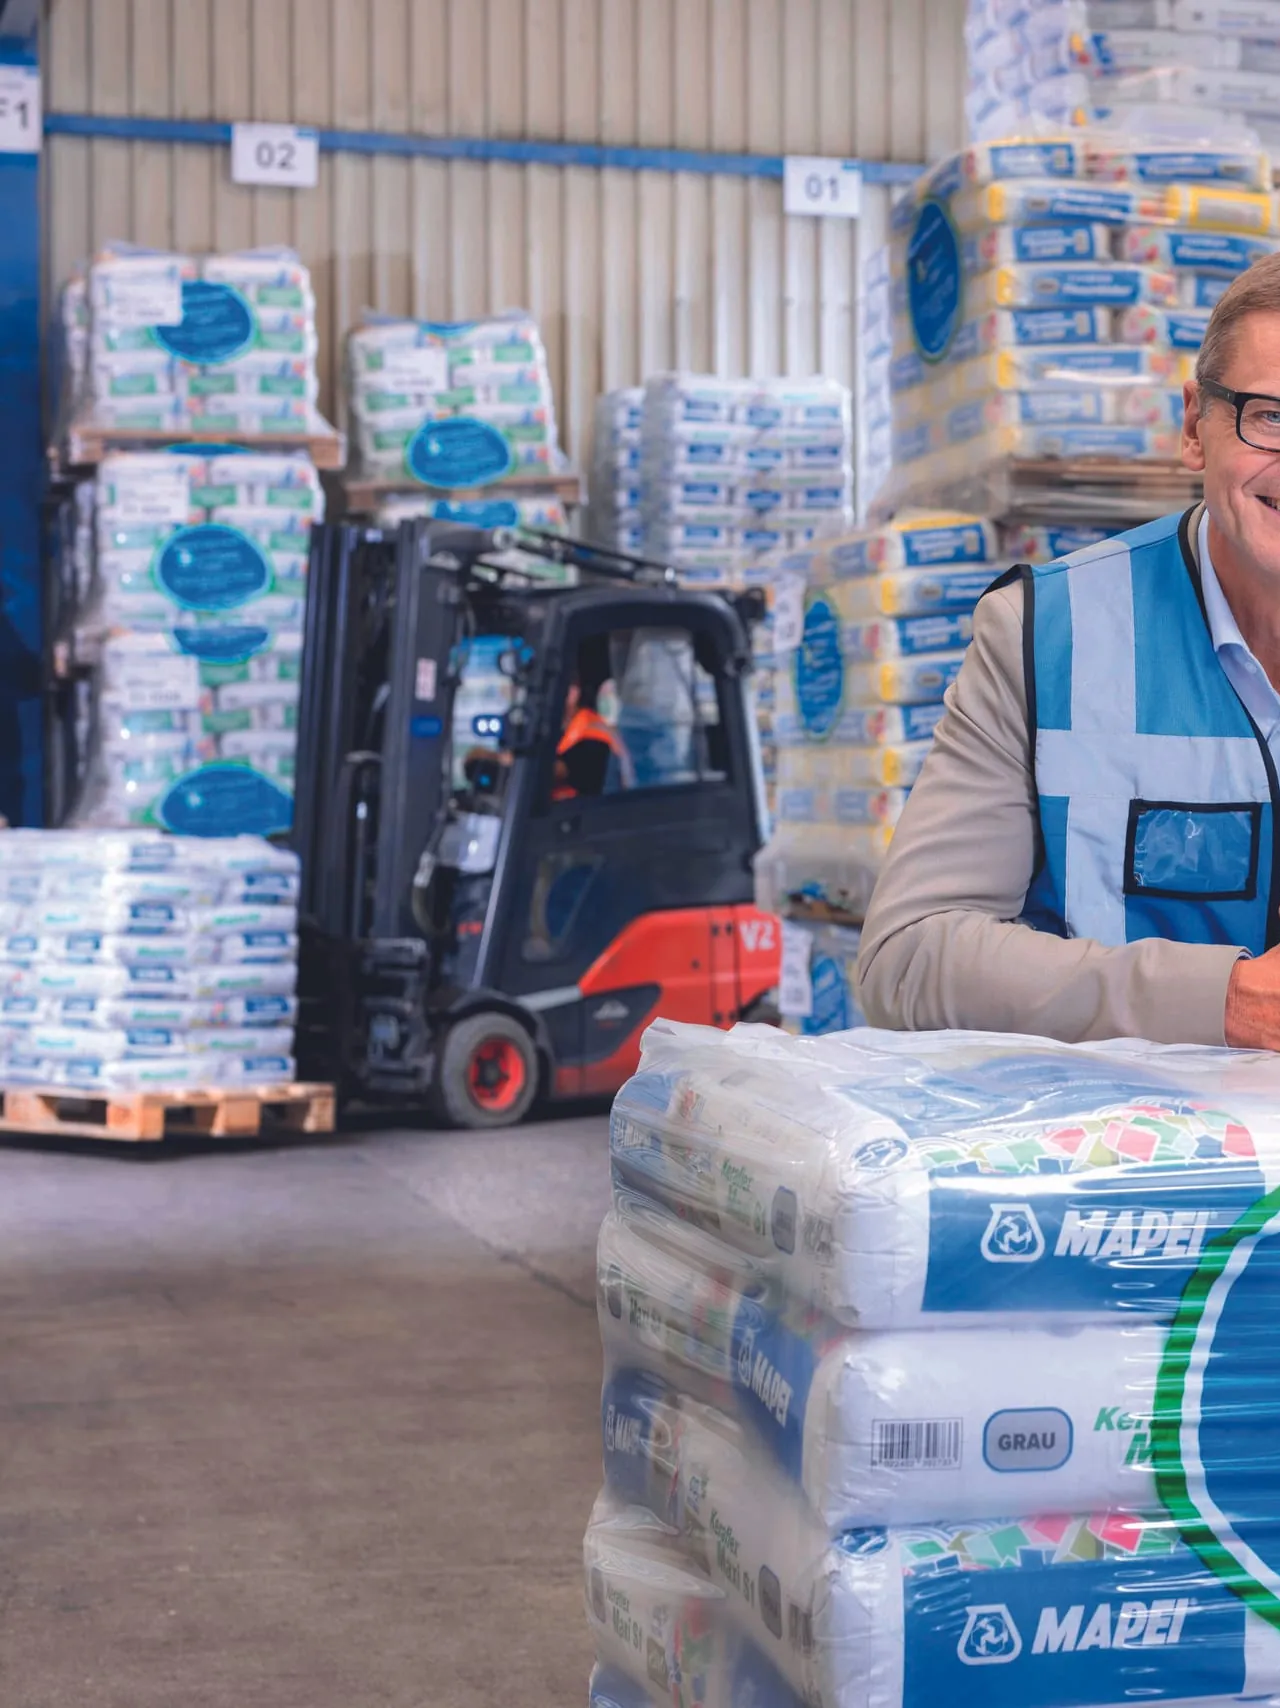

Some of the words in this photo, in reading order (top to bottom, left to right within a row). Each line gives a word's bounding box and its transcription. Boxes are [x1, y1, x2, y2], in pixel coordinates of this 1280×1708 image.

[255, 141, 296, 170] 02
[805, 173, 839, 202] 01
[740, 921, 775, 952] V2
[1053, 1210, 1209, 1256] MAPEI
[751, 1350, 793, 1428] MAPEI
[998, 1432, 1056, 1451] GRAU
[1031, 1598, 1189, 1654] MAPEI
